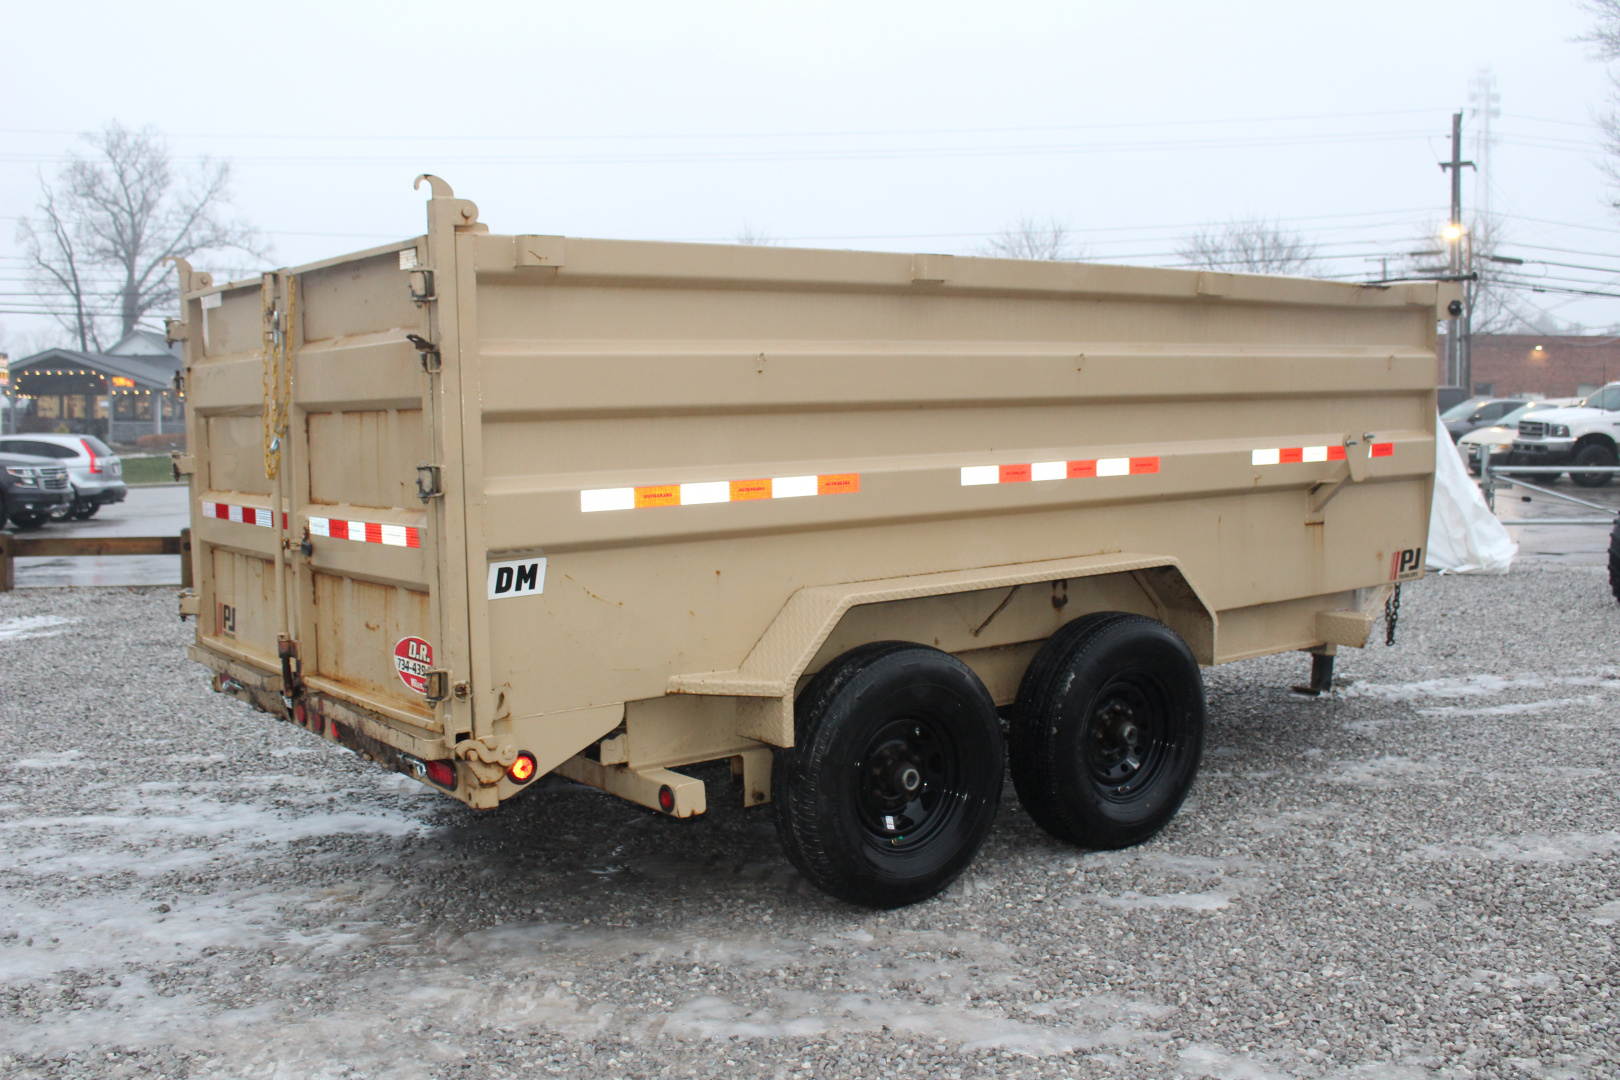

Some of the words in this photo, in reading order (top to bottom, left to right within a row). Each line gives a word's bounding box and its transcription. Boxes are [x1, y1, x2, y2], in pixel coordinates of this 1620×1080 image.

[1399, 547, 1422, 573] PJ
[494, 563, 539, 595] DM
[223, 604, 236, 633] PJ
[408, 640, 431, 664] D.R.
